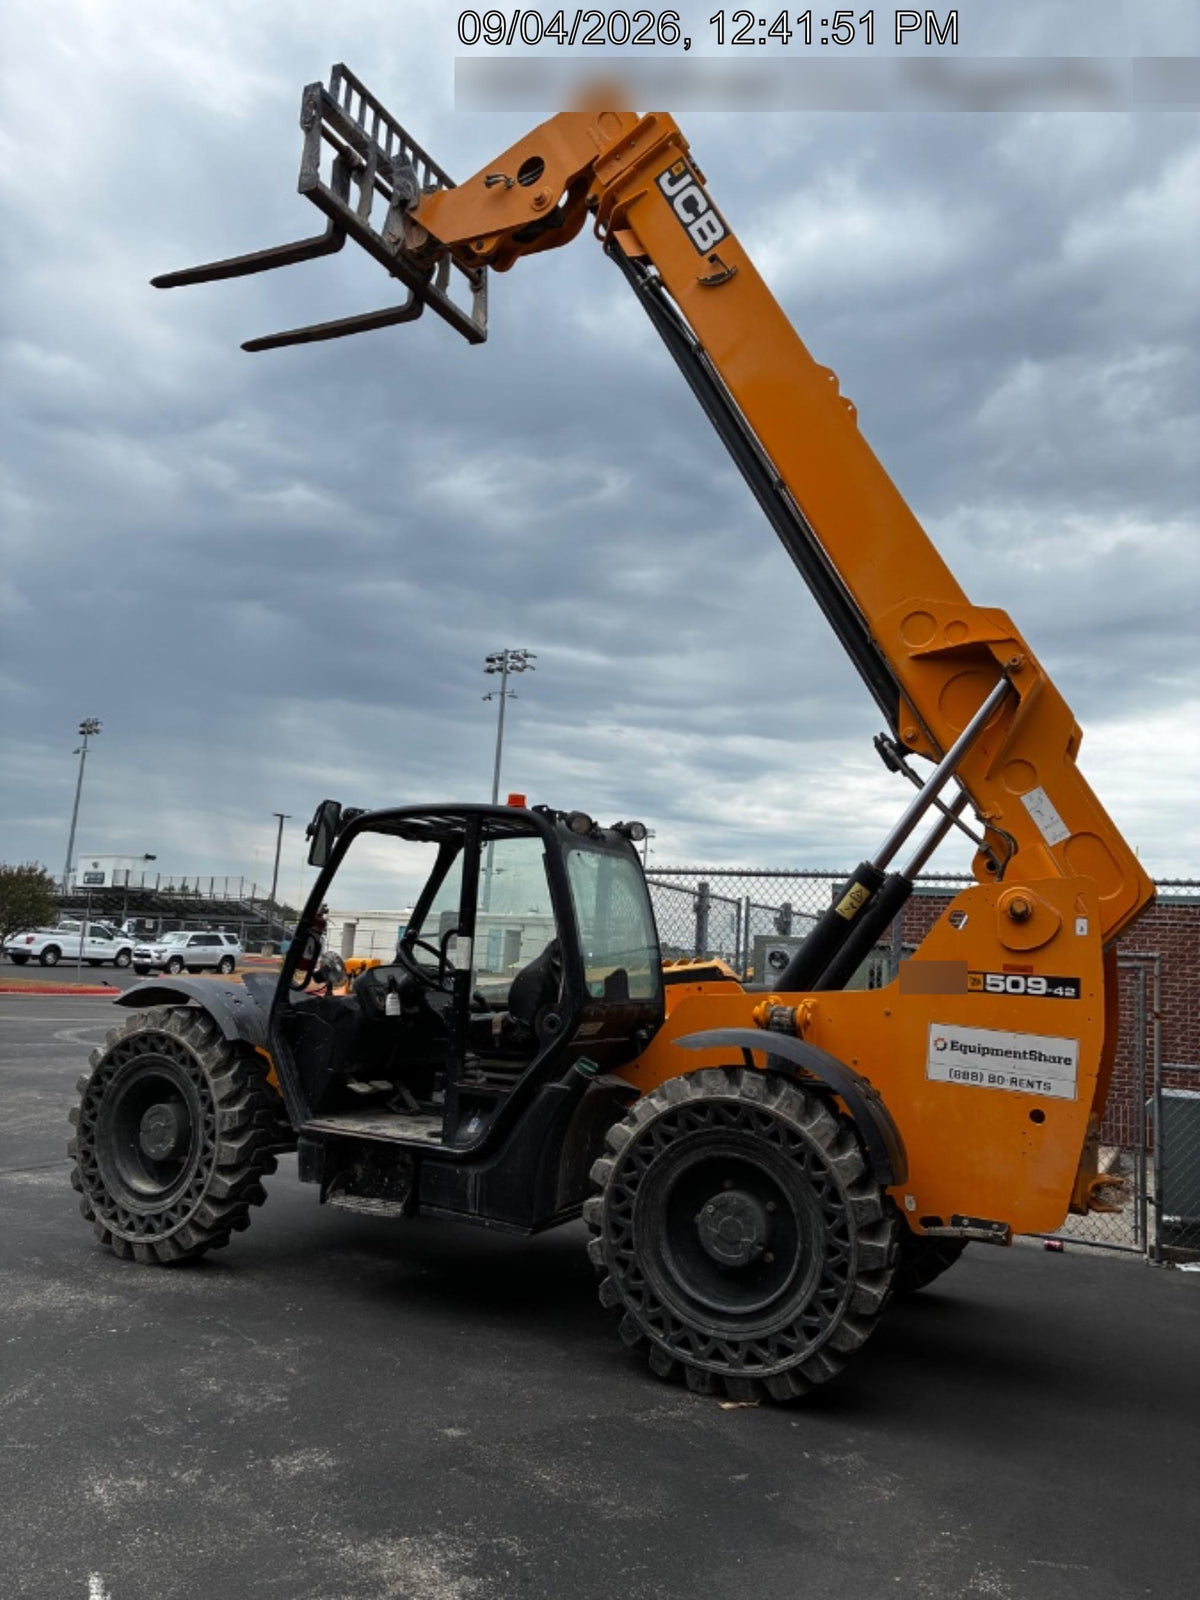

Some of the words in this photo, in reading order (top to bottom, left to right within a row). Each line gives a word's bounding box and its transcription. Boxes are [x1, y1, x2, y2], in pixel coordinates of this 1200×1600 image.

[659, 171, 724, 251] JCB
[985, 974, 1076, 997] 509-42
[950, 1040, 1072, 1065] EquipmentShare
[949, 1068, 984, 1083] (888)
